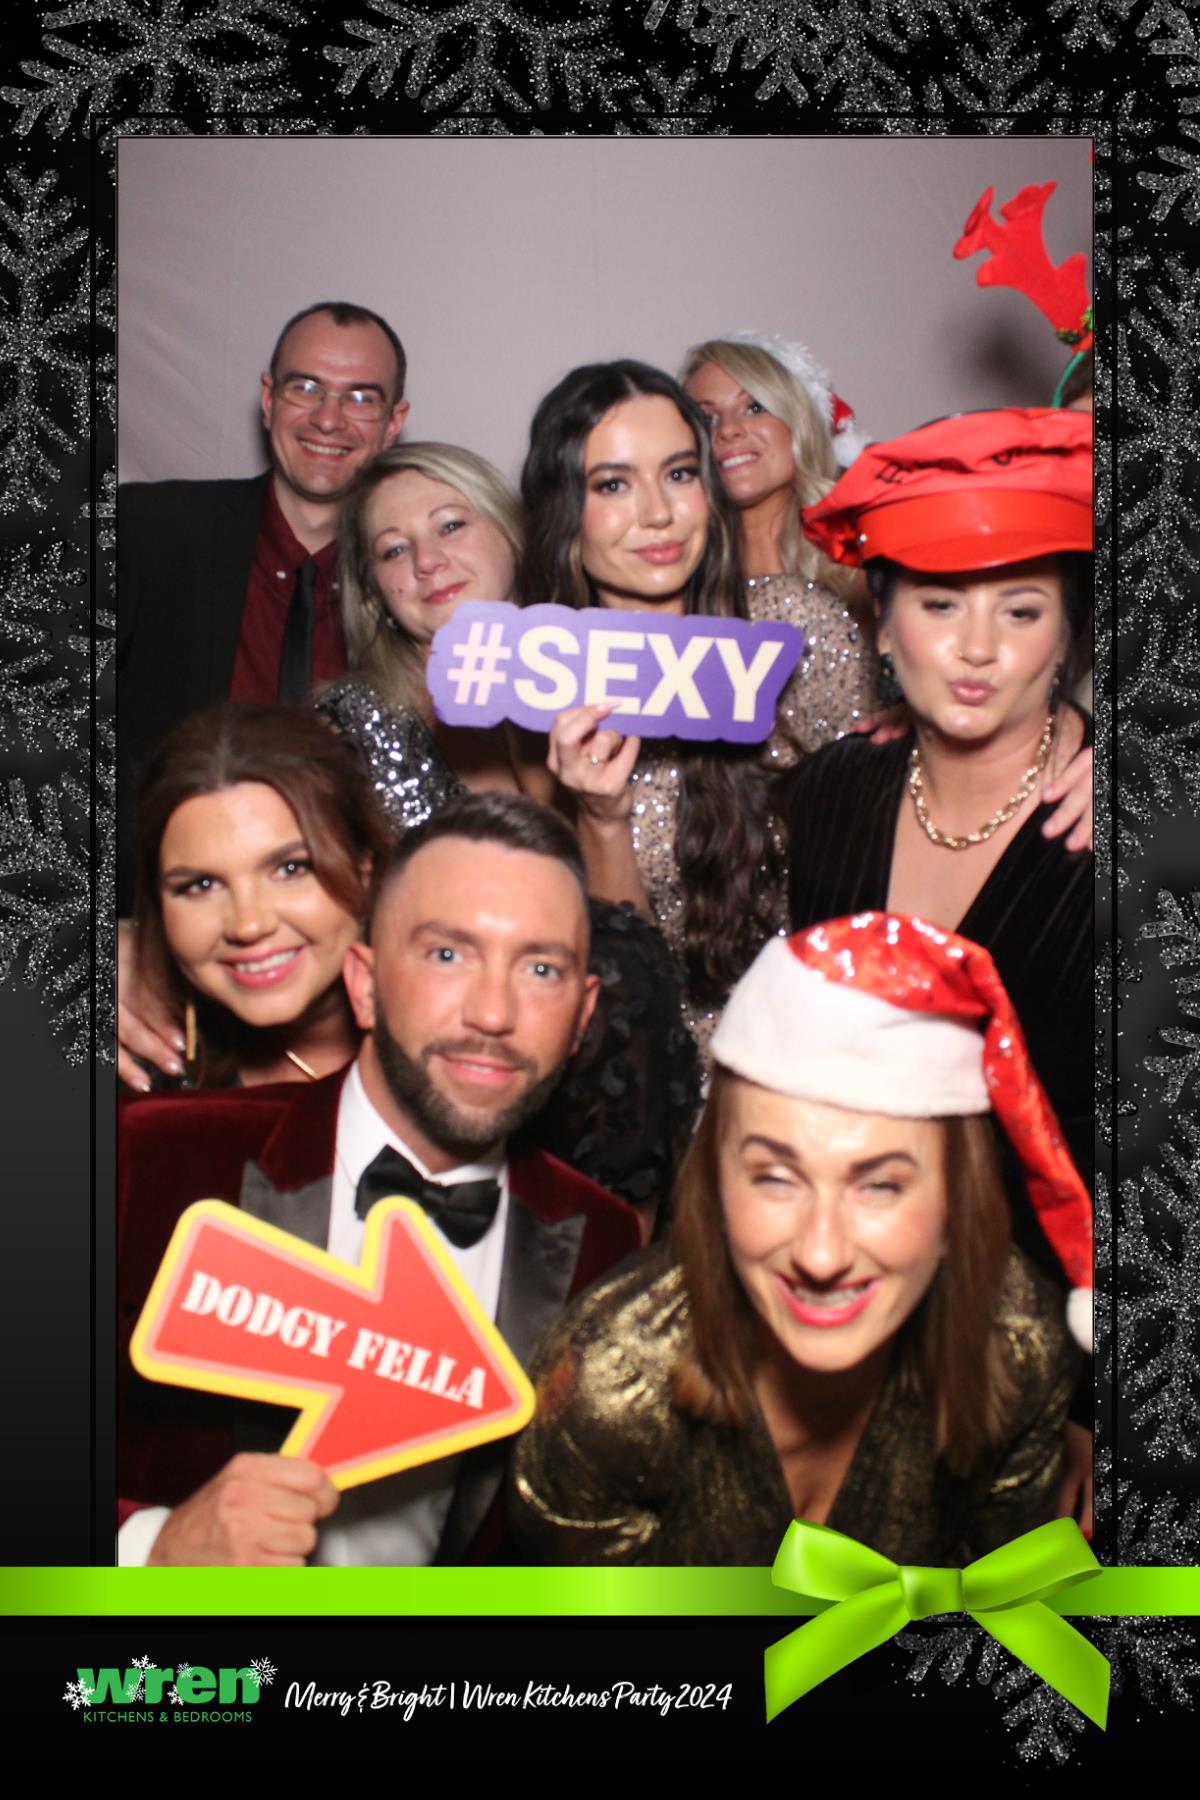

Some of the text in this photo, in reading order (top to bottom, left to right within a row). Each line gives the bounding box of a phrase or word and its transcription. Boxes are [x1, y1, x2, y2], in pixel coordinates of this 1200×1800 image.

[447, 621, 785, 723] #SEXY
[181, 1271, 486, 1410] DODGY FELLA
